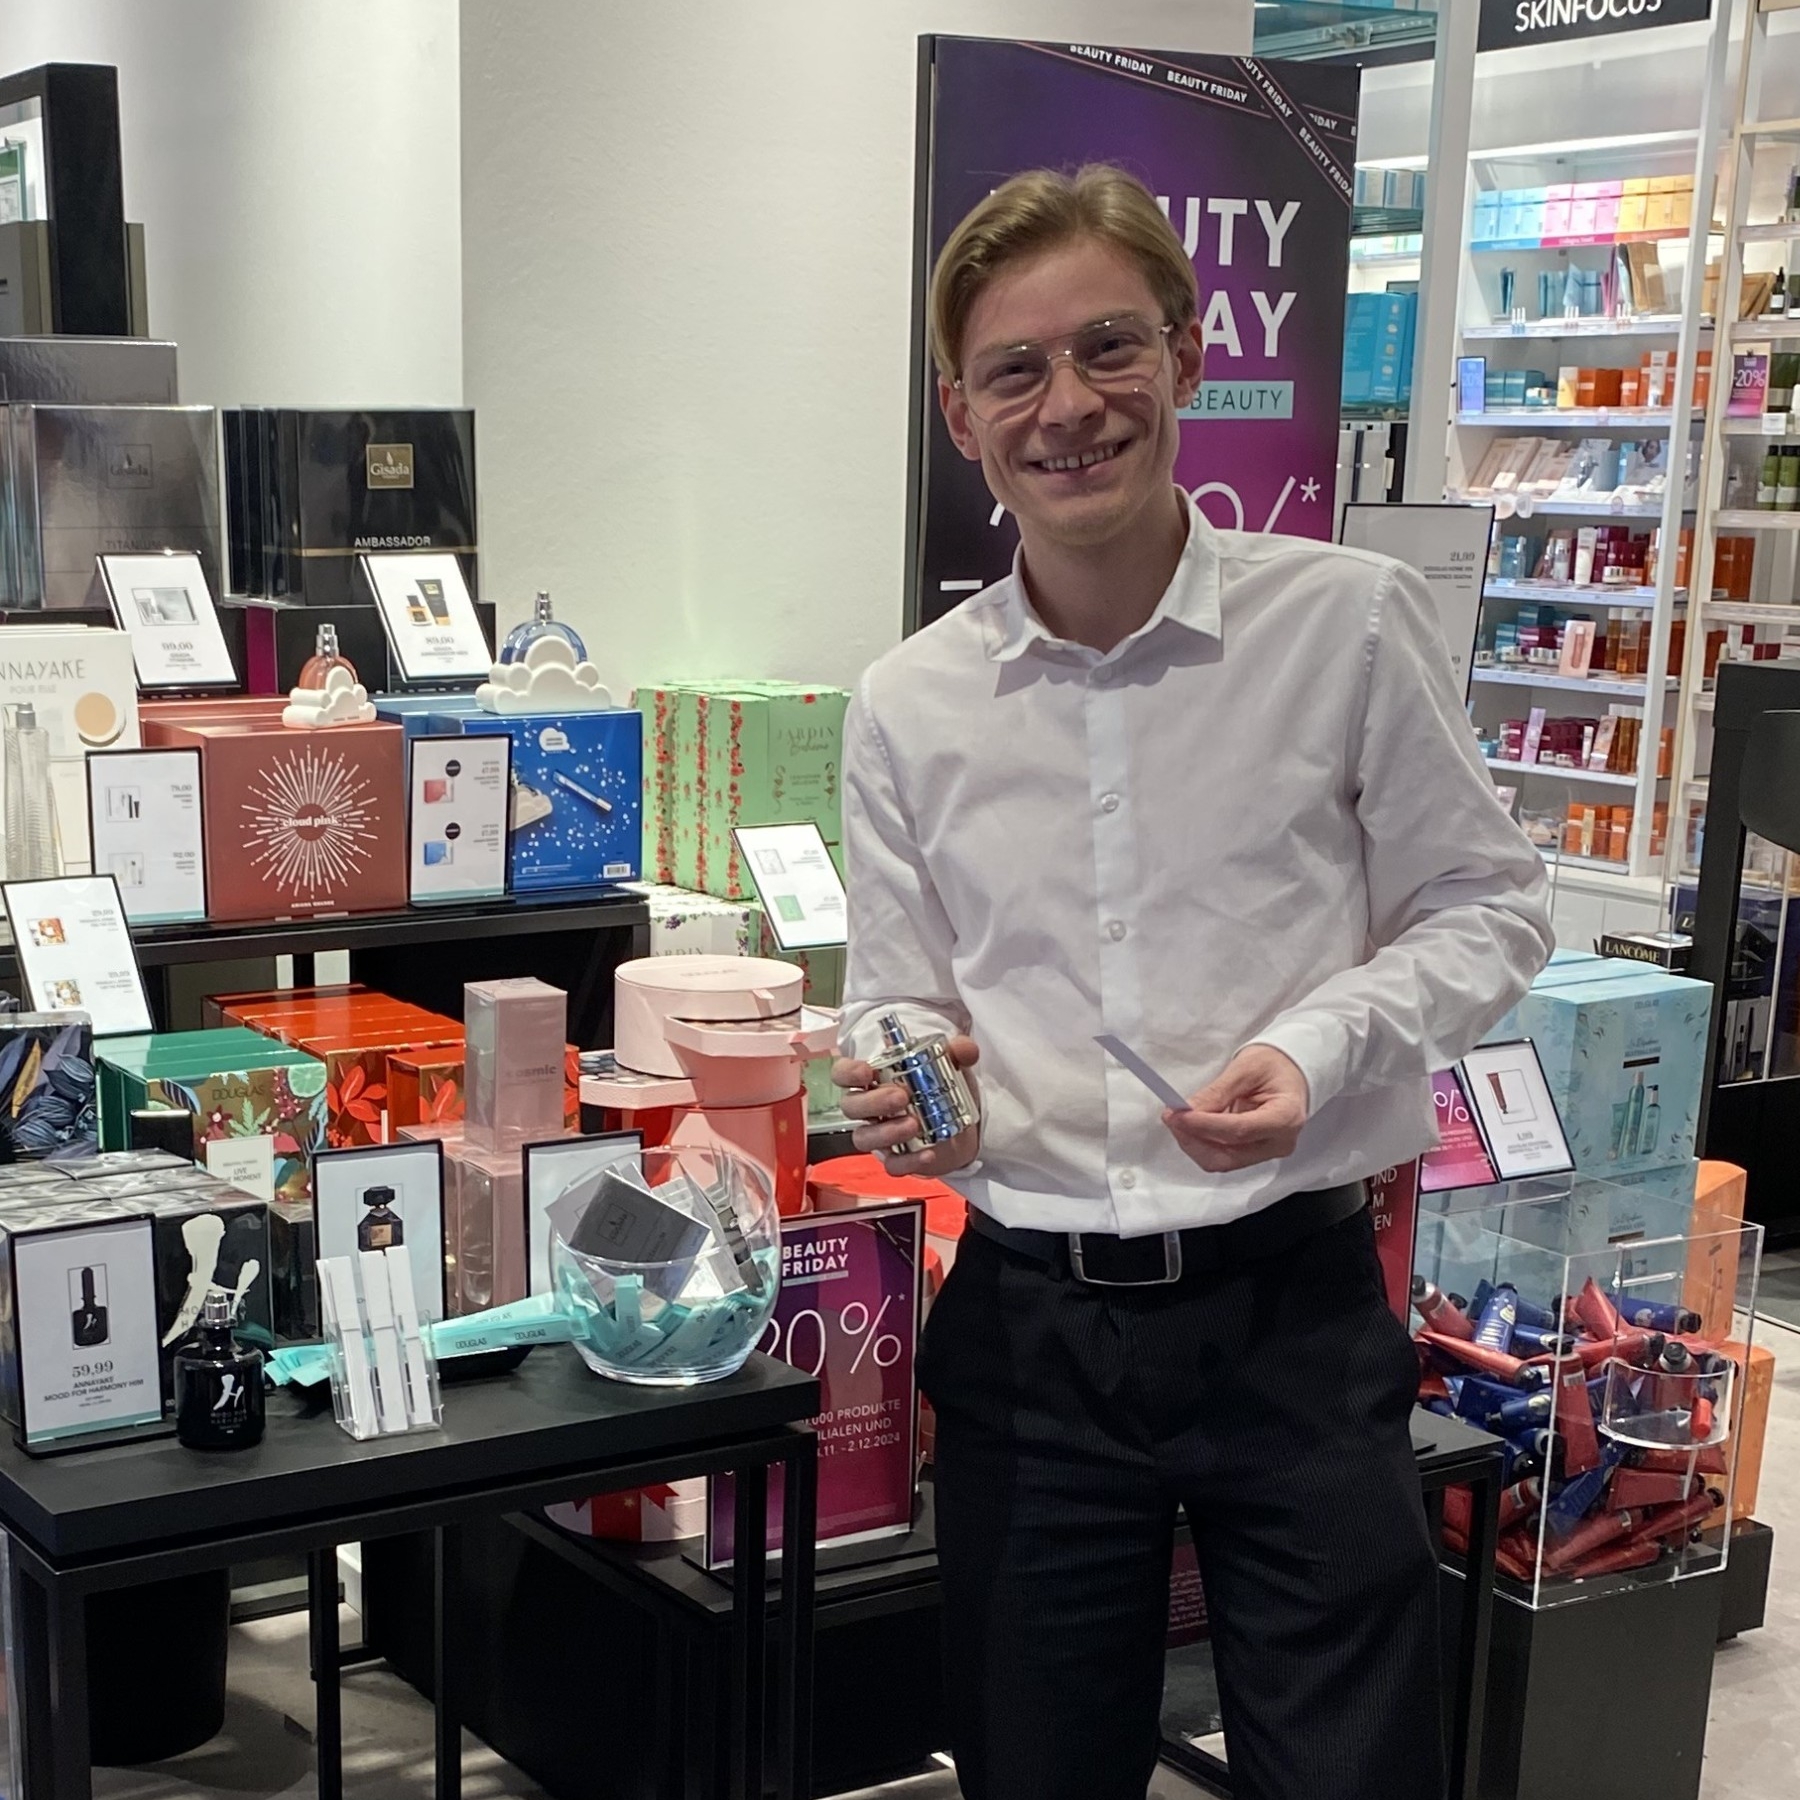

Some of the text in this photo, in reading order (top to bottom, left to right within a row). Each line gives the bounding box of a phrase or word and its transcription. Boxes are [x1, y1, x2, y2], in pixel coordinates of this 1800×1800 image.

[1069, 44, 1112, 64] BEAUTY
[1114, 54, 1154, 76] FRIDAY
[1166, 70, 1208, 92] BEAUTY
[1209, 83, 1248, 104] FRIDAY
[1261, 80, 1293, 119] FRIDAY
[1298, 127, 1331, 167] BEAUTY
[1190, 388, 1284, 411] BEAUTY
[370, 462, 411, 476] Gisada
[354, 535, 432, 548] AMBASSADOR
[0, 659, 86, 681] NAYAKE
[283, 814, 339, 828] cloud pink
[211, 1083, 265, 1101] DOUGLAS
[782, 1236, 849, 1261] BEAUTY
[782, 1253, 849, 1277] FRIDAY
[455, 1337, 488, 1350] DOUGLAS
[513, 1328, 547, 1341] DOUGLAS
[71, 1360, 114, 1379] 59,99
[43, 1391, 71, 1402] MOOD
[71, 1388, 88, 1398] FOR
[88, 1381, 128, 1394] HARMONY
[72, 1377, 115, 1390] ANNAYAKE
[837, 1398, 902, 1421] PRODUKTE
[816, 1417, 893, 1442] ILIALEN UND
